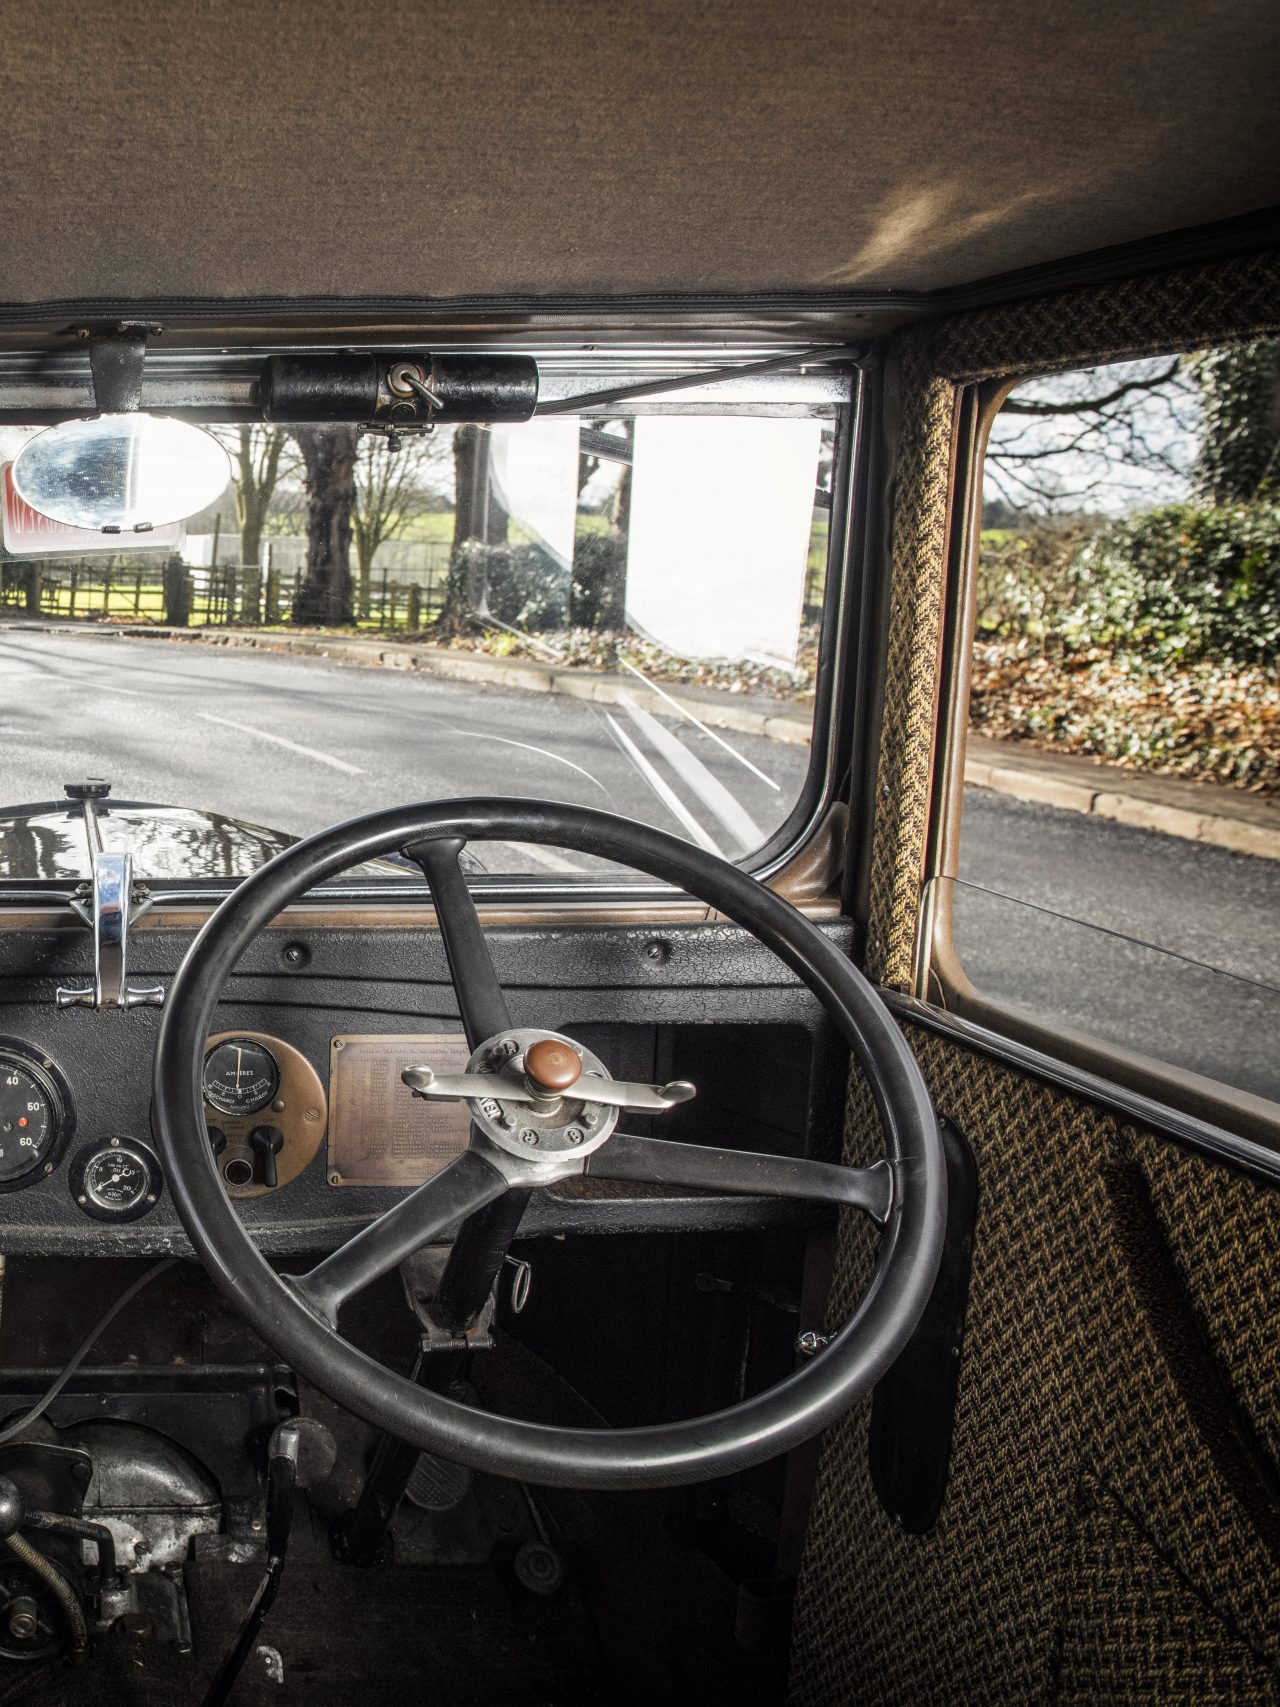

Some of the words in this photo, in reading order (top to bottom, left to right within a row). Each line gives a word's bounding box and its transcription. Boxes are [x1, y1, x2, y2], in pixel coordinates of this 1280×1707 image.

[6, 1076, 19, 1085] 40
[27, 1102, 40, 1110] 50
[20, 1138, 33, 1146] 60
